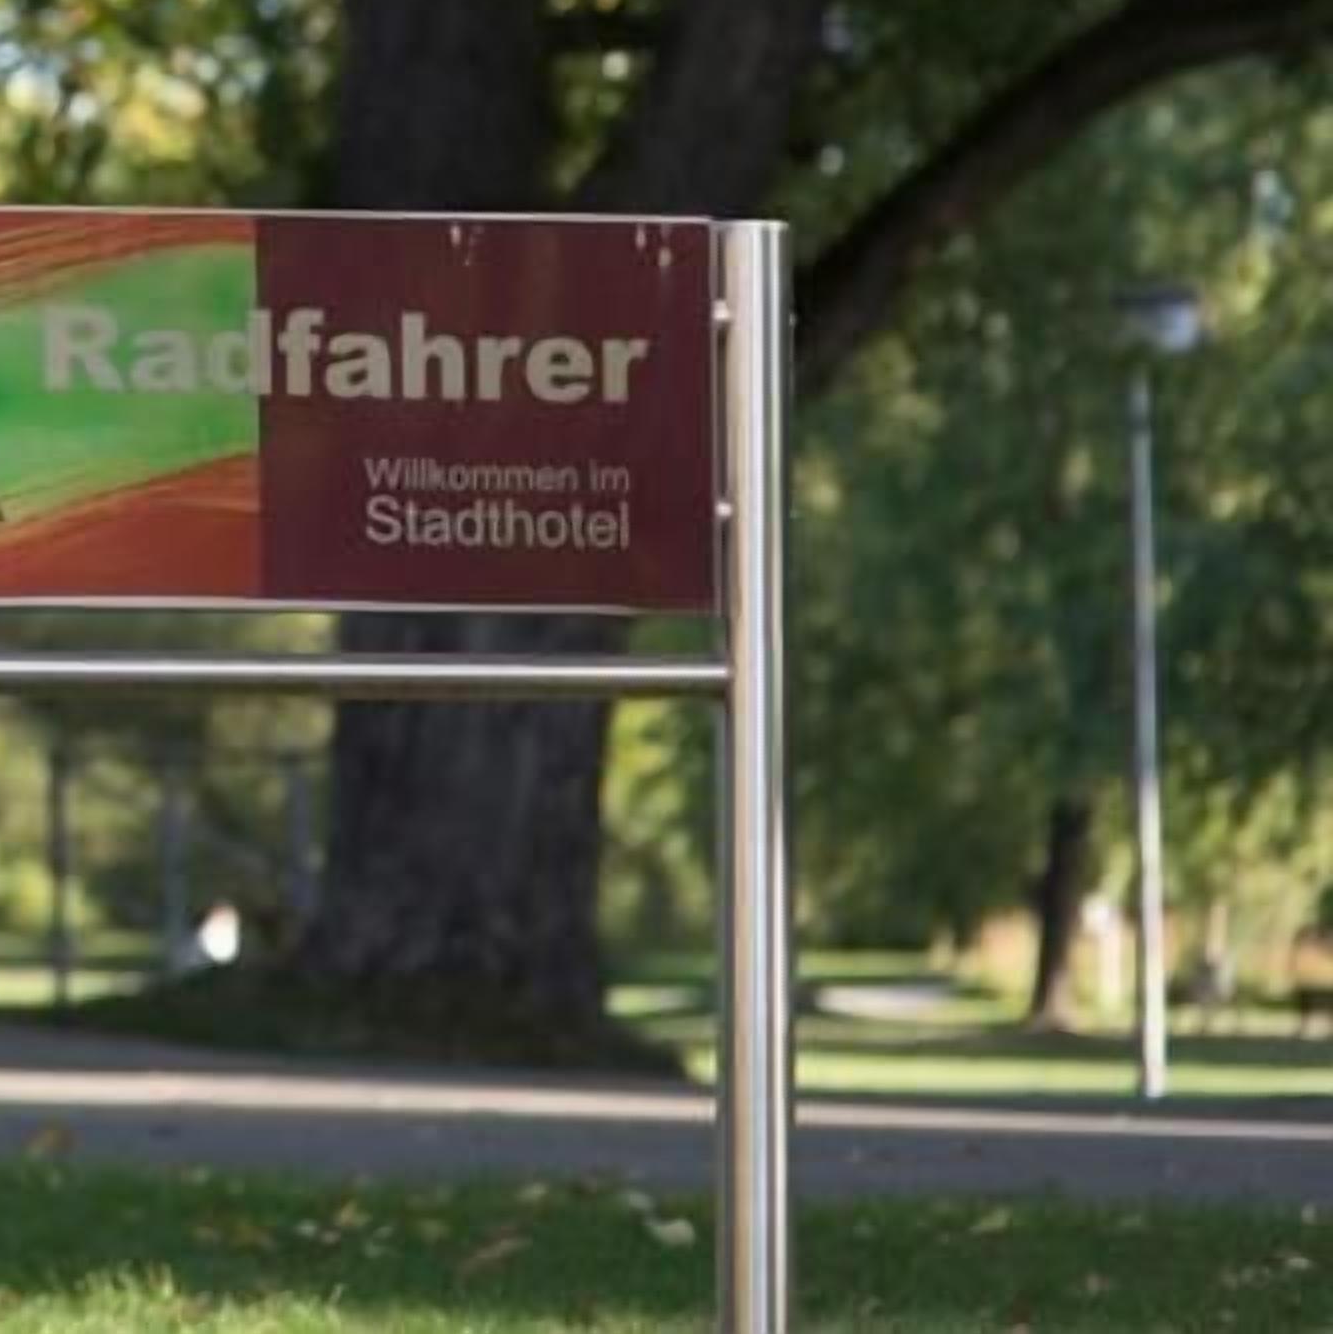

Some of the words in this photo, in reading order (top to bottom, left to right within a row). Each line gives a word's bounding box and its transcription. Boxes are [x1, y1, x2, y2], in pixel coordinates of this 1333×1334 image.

[42, 305, 649, 403] Radfahrer
[364, 457, 579, 492] Willkommen
[589, 460, 631, 492] im
[365, 495, 630, 549] Stadthotel
